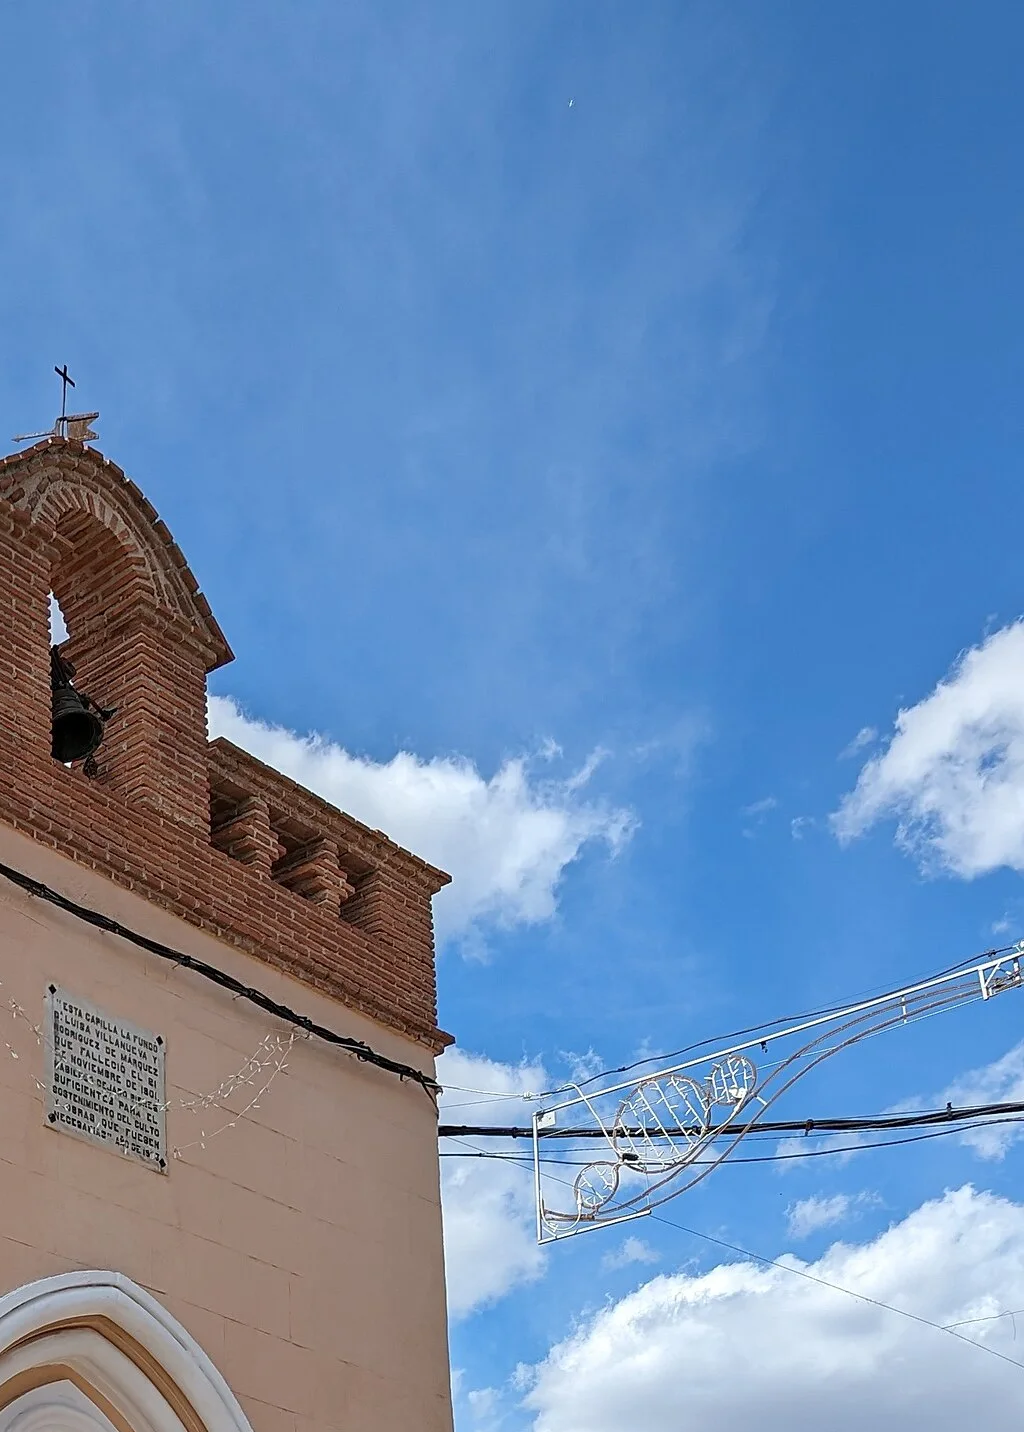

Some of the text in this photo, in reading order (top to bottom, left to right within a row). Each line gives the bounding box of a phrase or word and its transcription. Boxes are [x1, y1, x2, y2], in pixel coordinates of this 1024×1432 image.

[64, 1015, 90, 1033] LUISA
[94, 1029, 147, 1060] VILLANUEVA
[151, 1055, 157, 1065] Y
[84, 1012, 117, 1034] CAPILLA
[120, 1028, 130, 1041] LA
[132, 1034, 158, 1053] FUNDÓ
[53, 1035, 73, 1050] QUE
[79, 1046, 125, 1074] FALLECIÓ
[130, 1069, 142, 1082] EL
[70, 1054, 121, 1084] NOVIEMBRE
[125, 1078, 136, 1091] DE
[105, 1045, 116, 1058] DE
[120, 1052, 158, 1077] MÁRQUEZ
[52, 1085, 159, 1137] SOSTENIMIENTO DEL CULTO
[53, 1073, 158, 1125] SUFICIENTES PARA EL
[101, 1118, 119, 1133] QUE
[125, 1128, 159, 1149] FUESEN
[131, 1142, 140, 1153] DE
